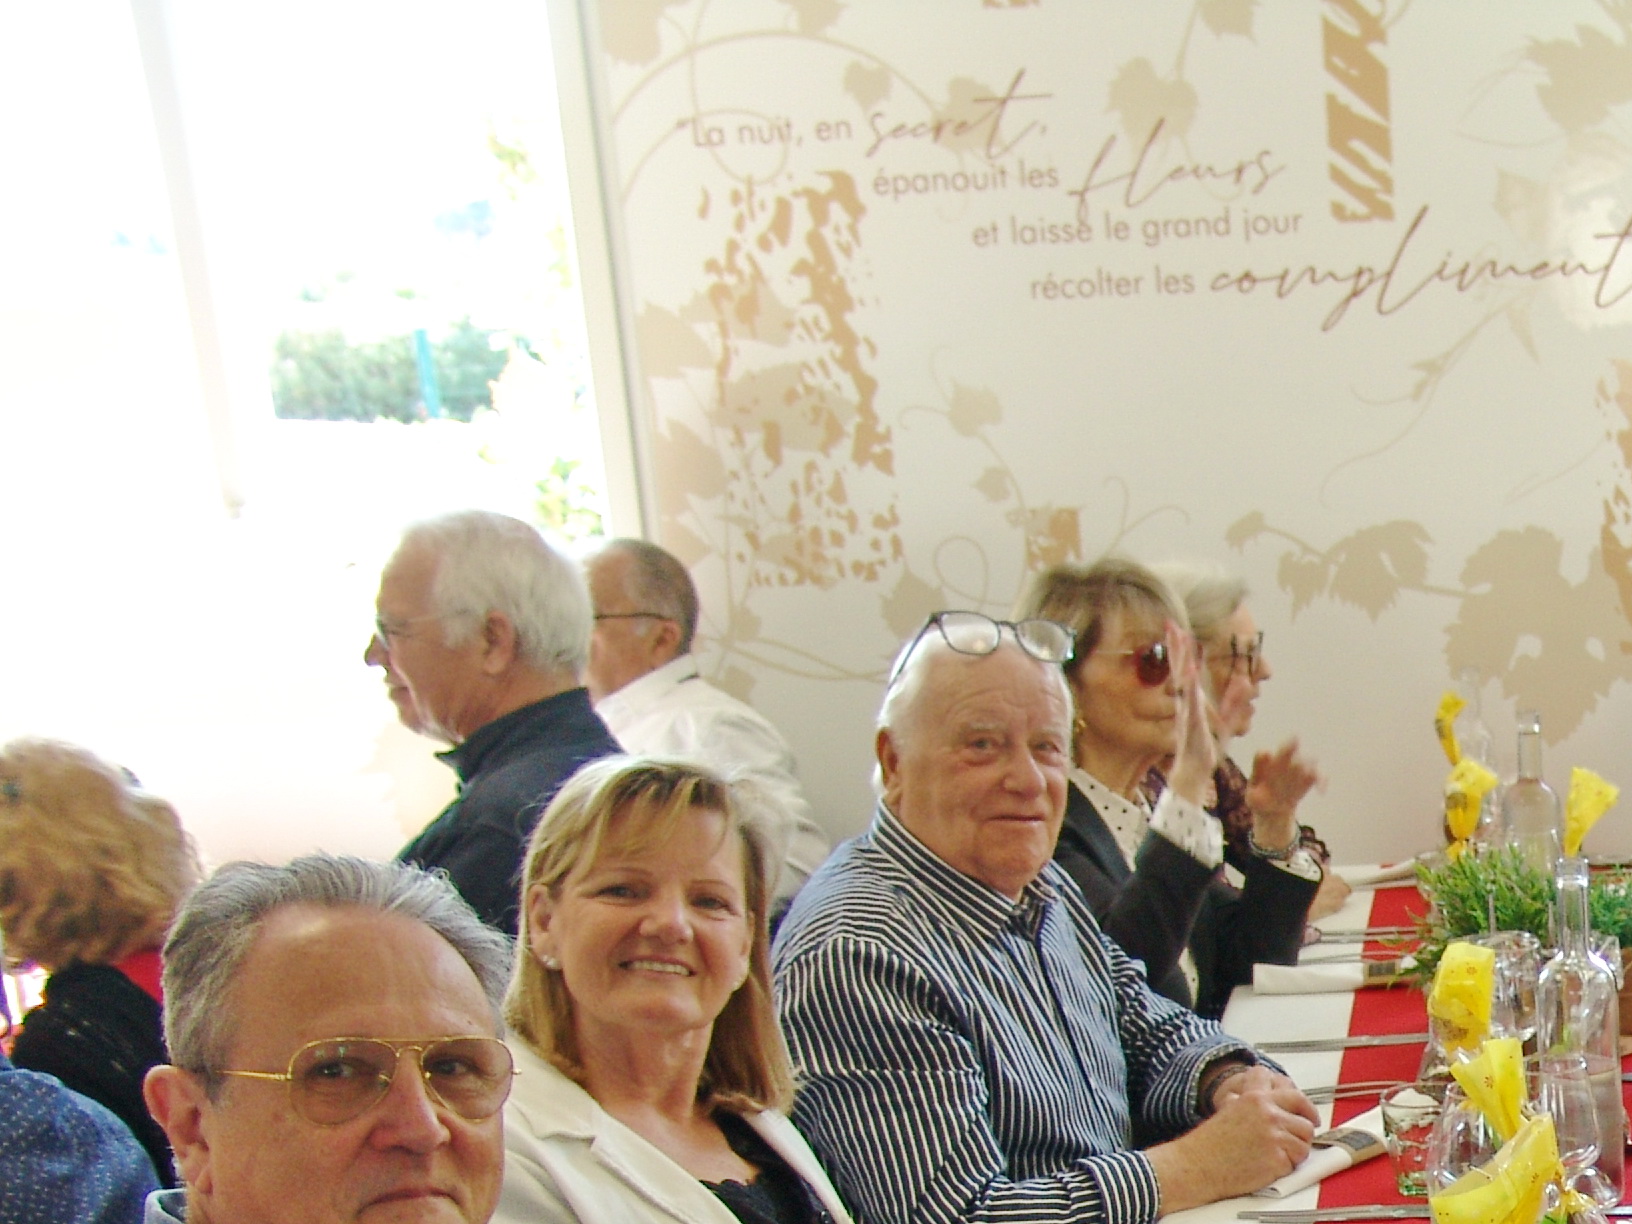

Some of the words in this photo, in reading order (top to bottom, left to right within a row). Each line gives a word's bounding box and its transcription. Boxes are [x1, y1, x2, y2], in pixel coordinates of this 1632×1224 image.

[738, 114, 803, 147] nuit,
[815, 119, 852, 142] en
[872, 164, 1007, 199] épanouit
[1018, 159, 1059, 189] les
[1066, 117, 1286, 223] fleurs
[972, 221, 999, 248] et
[1104, 210, 1130, 242] le
[1141, 206, 1232, 248] grand
[1242, 207, 1303, 243] jour
[1030, 266, 1144, 301] récolter
[1154, 264, 1195, 295] les
